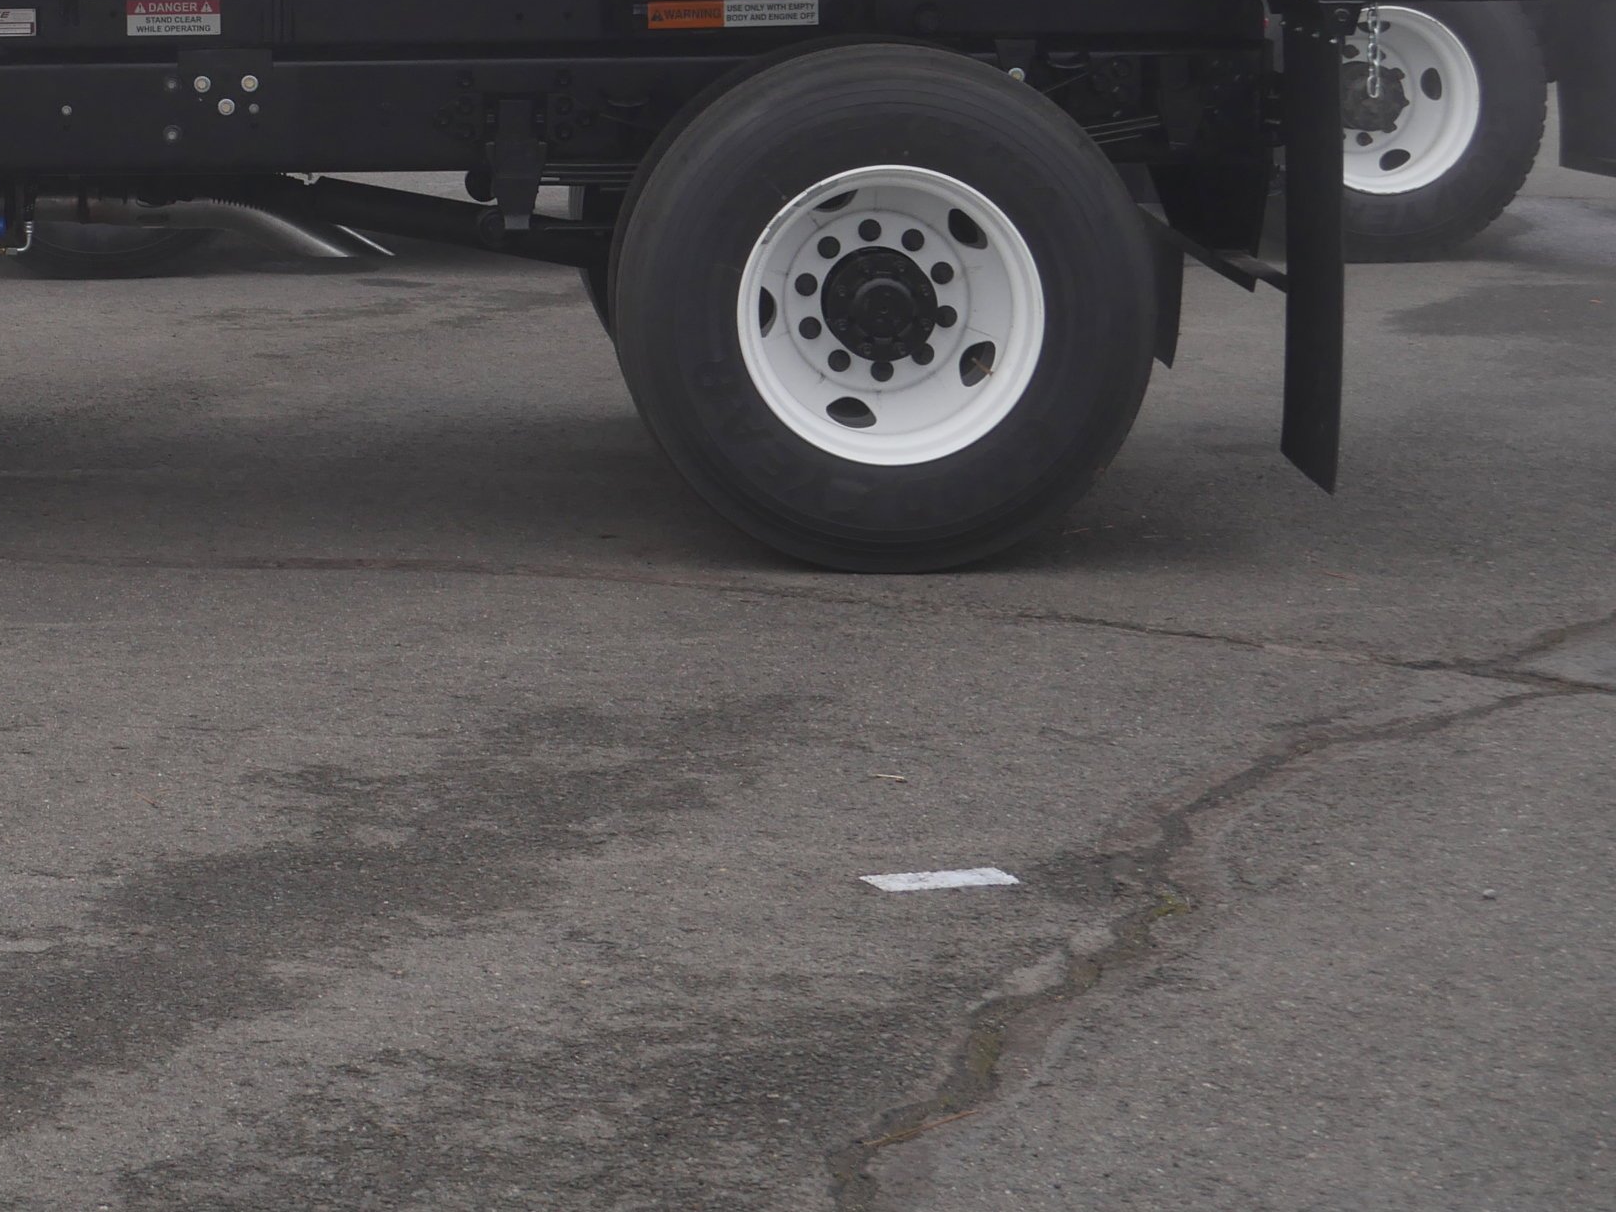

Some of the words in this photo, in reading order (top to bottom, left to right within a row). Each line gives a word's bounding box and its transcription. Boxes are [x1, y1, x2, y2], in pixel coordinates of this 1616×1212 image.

[148, 2, 198, 13] DANGER
[726, 4, 742, 12] USE
[744, 4, 764, 12] ONLY
[766, 3, 786, 11] WITH
[664, 8, 722, 21] WARNING
[726, 13, 748, 22] BODY
[749, 13, 767, 21] AND
[768, 12, 798, 20] ENGINE
[145, 16, 171, 24] STAND
[174, 16, 202, 24] CLEAR
[136, 25, 162, 33] WHILE
[164, 24, 212, 33] OPERATING
